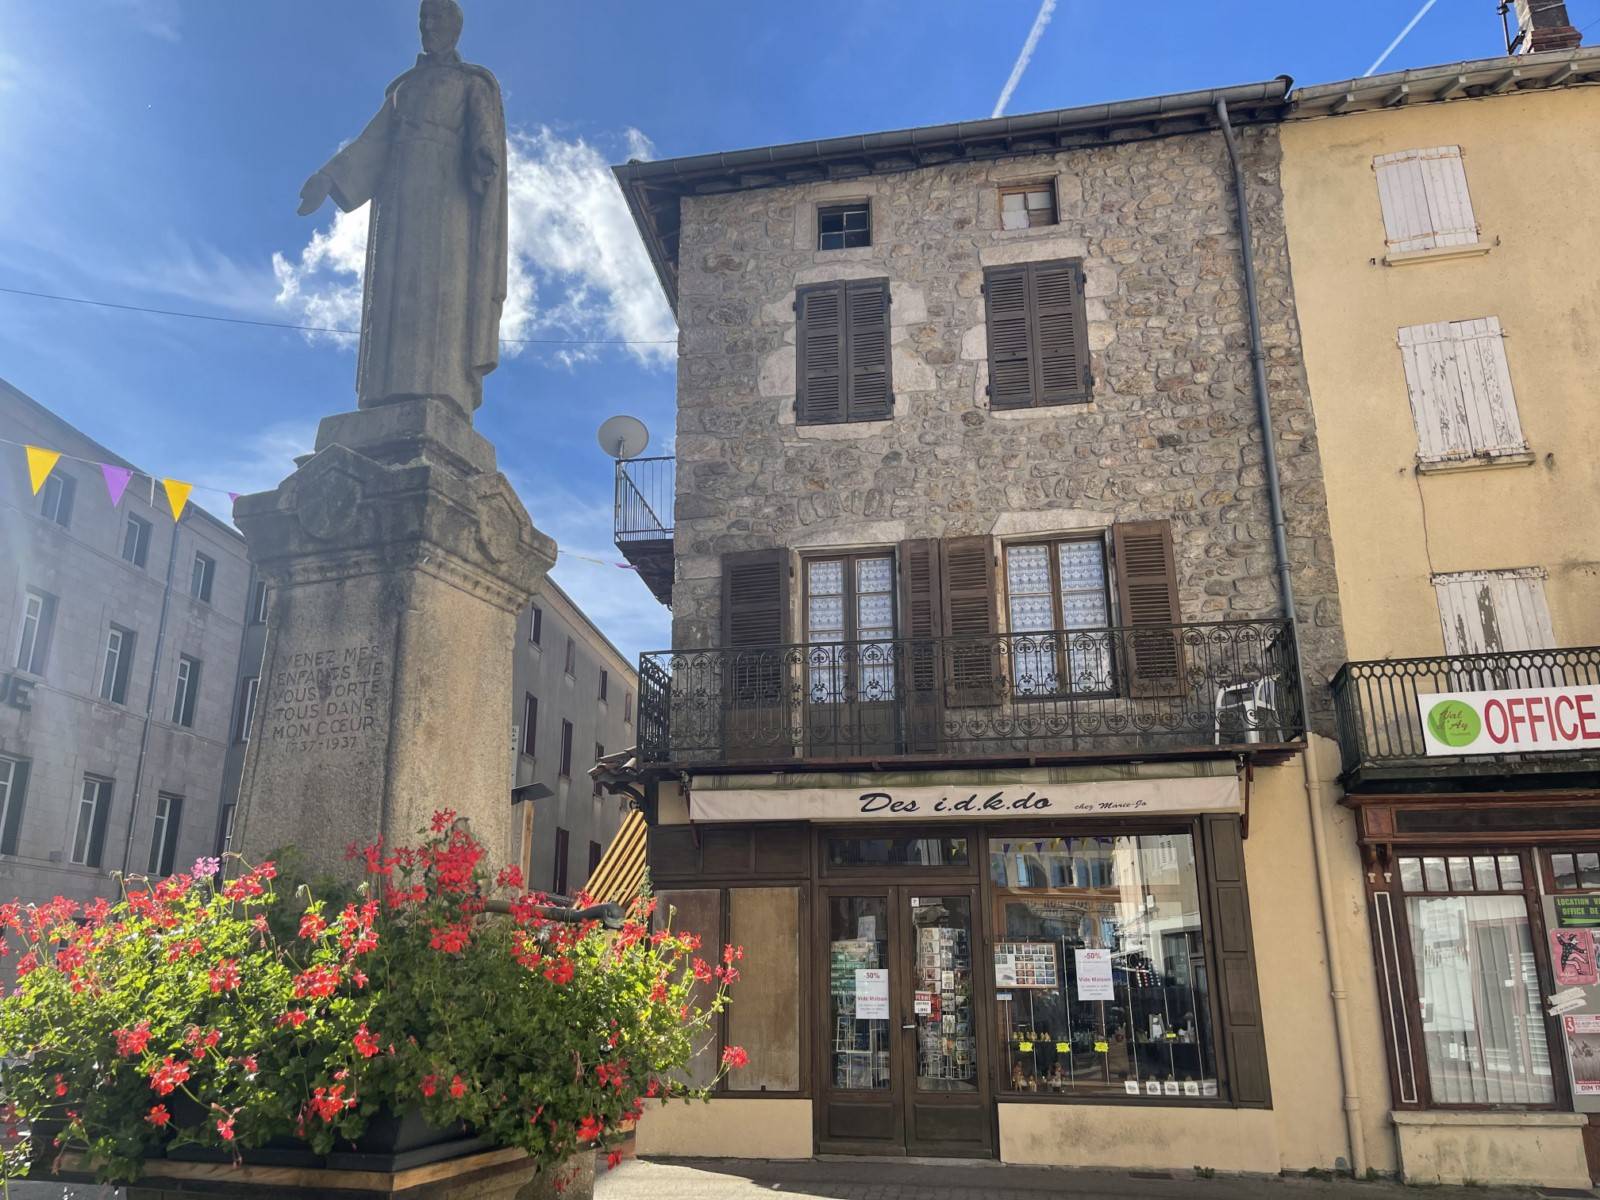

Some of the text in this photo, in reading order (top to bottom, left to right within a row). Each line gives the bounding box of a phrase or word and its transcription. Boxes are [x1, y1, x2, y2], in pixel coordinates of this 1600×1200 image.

[283, 646, 380, 668] VENEZ MES
[329, 680, 381, 699] ORTE
[274, 698, 373, 721] TOUS DANS
[1484, 695, 1600, 744] OFFICE
[272, 723, 311, 740] MON
[859, 792, 920, 813] Des
[934, 791, 1052, 812] i.d.k.do
[1557, 898, 1590, 906] LOCATION
[1562, 907, 1585, 915] OFFICE
